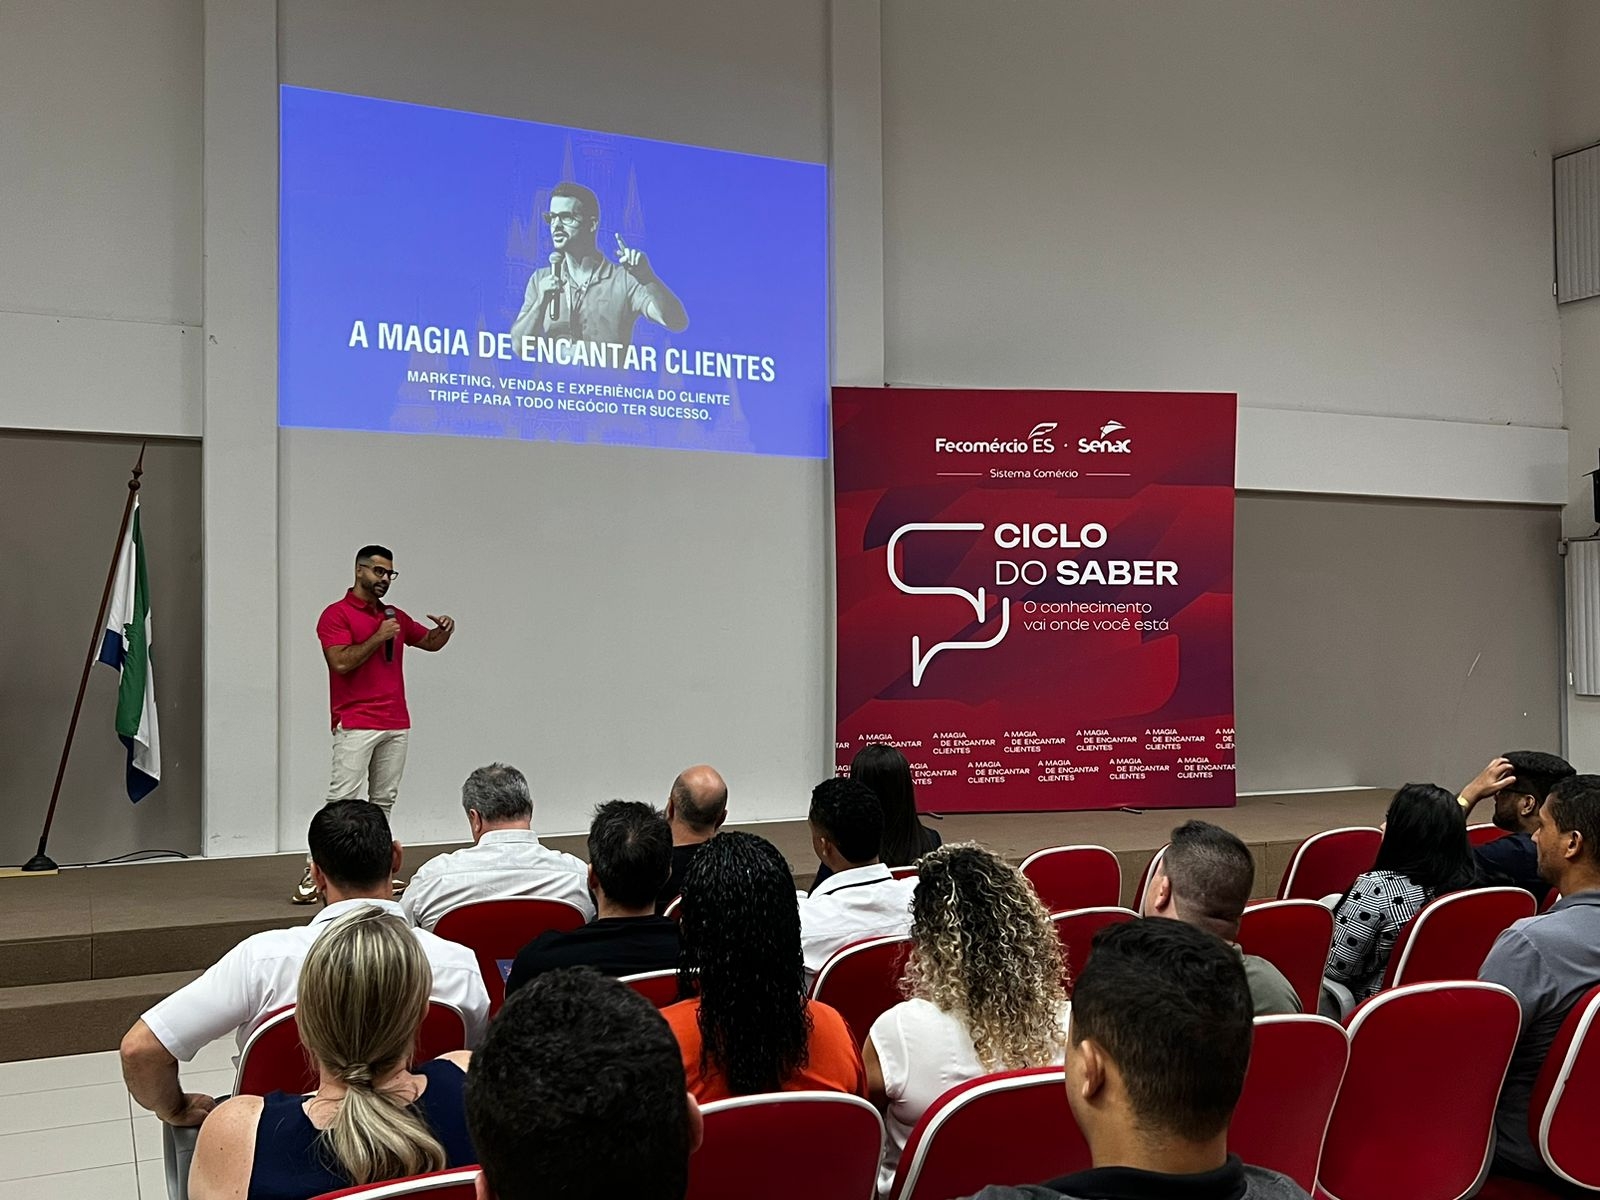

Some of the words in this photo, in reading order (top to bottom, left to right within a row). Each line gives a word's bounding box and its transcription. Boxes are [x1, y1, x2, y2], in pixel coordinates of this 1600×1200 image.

[349, 320, 369, 348] A
[378, 322, 470, 357] MAGIA
[478, 331, 512, 360] DE
[521, 335, 657, 372] ENCANTAR
[665, 348, 775, 383] CLIENTES
[407, 370, 495, 389] MARKETING,
[499, 377, 553, 393] VENDAS
[557, 382, 565, 393] E
[569, 383, 654, 400] EXPERIÊNCIA
[657, 389, 676, 401] DO
[679, 391, 730, 406] CLIENTE
[428, 389, 469, 404] TRIPÉ
[474, 393, 511, 406] PARA
[515, 396, 554, 410] TODO
[557, 398, 618, 414] NEGÓCIO
[622, 403, 647, 416] TER
[649, 405, 712, 421] SUCESSO.
[935, 437, 1028, 453] Fecomércio
[1032, 438, 1055, 453] ES
[1078, 438, 1131, 454] Senac
[989, 468, 1031, 478] Sistema
[1033, 468, 1079, 479] Comércio
[994, 522, 1108, 549] CICLO
[995, 560, 1047, 586] DO
[1056, 560, 1179, 586] SABER
[1023, 601, 1037, 614] O
[1040, 600, 1152, 614] conhecimento
[1023, 618, 1046, 631] vai
[1049, 618, 1090, 631] onde
[1093, 618, 1131, 631] você
[1134, 618, 1169, 631] está
[1011, 730, 1037, 738] MAGIA
[1011, 738, 1022, 746] DE
[1024, 737, 1066, 745] ENCANTAR
[1096, 736, 1137, 744] ENCANTAR
[1164, 735, 1205, 743] ENCANTAR
[932, 747, 971, 755] CLIENTES
[1003, 745, 1041, 753] CLIENTES
[1076, 744, 1113, 752] CLIENTES
[1058, 766, 1099, 774] ENCANTAR
[1129, 764, 1170, 772] ENCANTAR
[1037, 774, 1075, 782] CLIENTES
[1109, 772, 1146, 780] CLIENTES
[1177, 771, 1213, 779] CLIENTES
[967, 776, 1005, 784] CLIENTES
